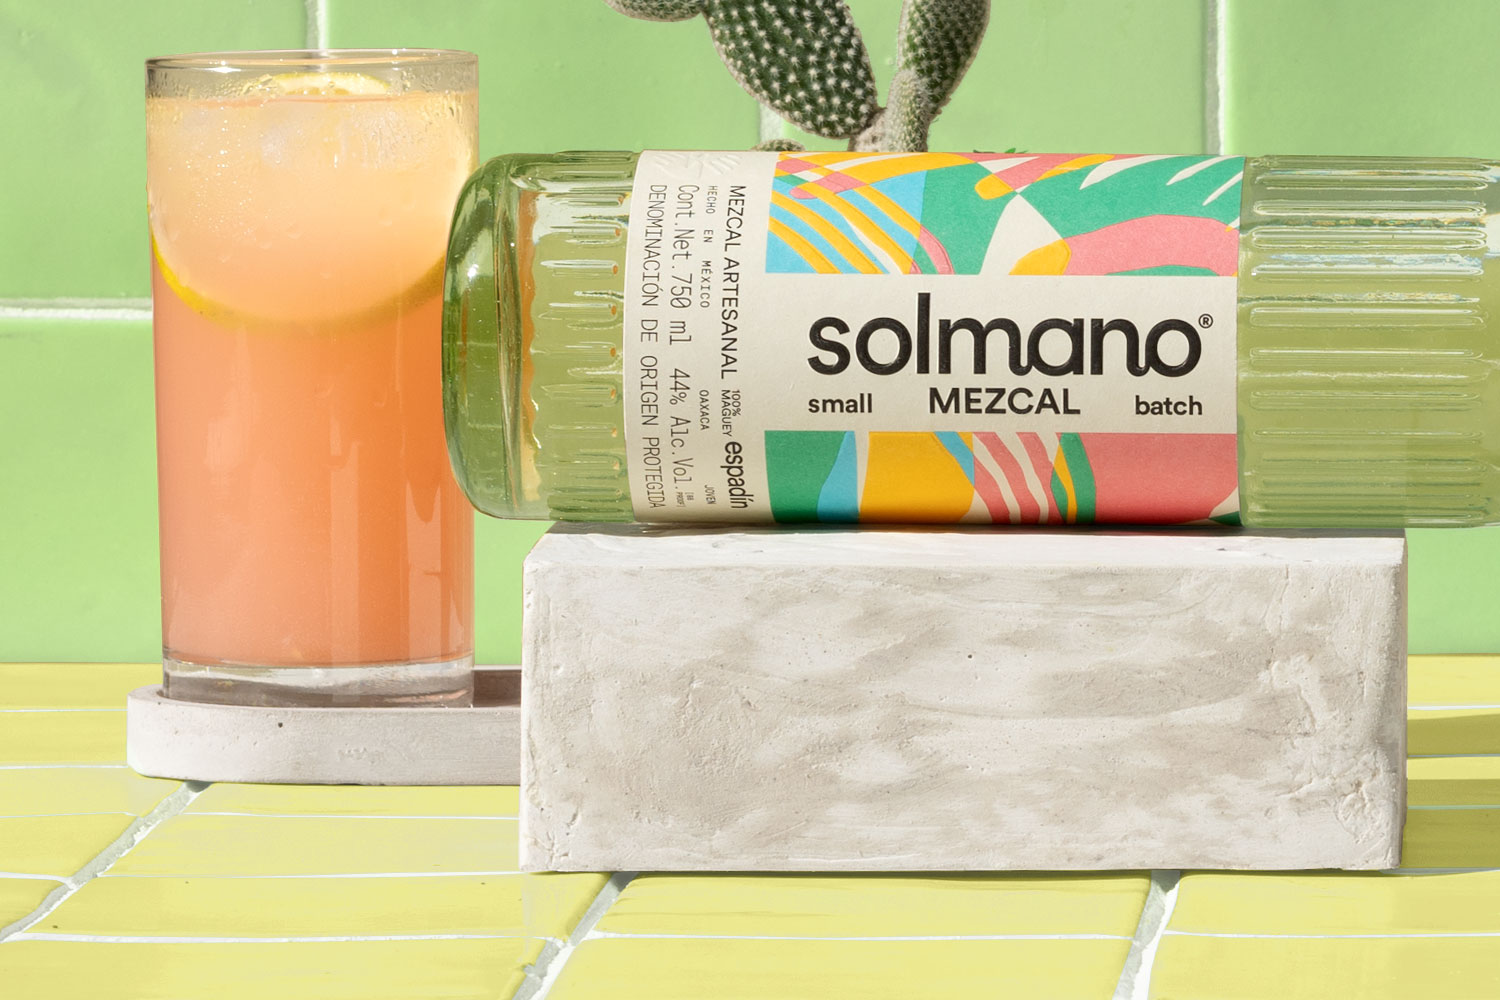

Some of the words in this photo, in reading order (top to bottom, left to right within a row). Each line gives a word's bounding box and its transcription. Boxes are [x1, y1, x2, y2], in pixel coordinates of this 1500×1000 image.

[706, 186, 718, 214] HECHO
[724, 186, 746, 252] MEZCAL
[642, 185, 667, 306] DENOMINACIÓN
[704, 230, 713, 243] EN
[700, 261, 713, 308] MÉXICO
[641, 319, 658, 342] DE
[669, 321, 691, 345] ml
[721, 257, 740, 379] ARTESANAL
[641, 356, 658, 425] ORIGEN
[669, 368, 691, 405] 44%
[732, 390, 741, 416] 100%
[808, 394, 872, 414] small
[929, 387, 1080, 416] MEZCAL
[1135, 395, 1203, 416] batch
[699, 390, 709, 430] OAXACA
[721, 390, 732, 436] MAGUEY
[642, 437, 665, 508] PROTEGIDA
[721, 442, 754, 508] espadín
[705, 485, 716, 504] JOVEN
